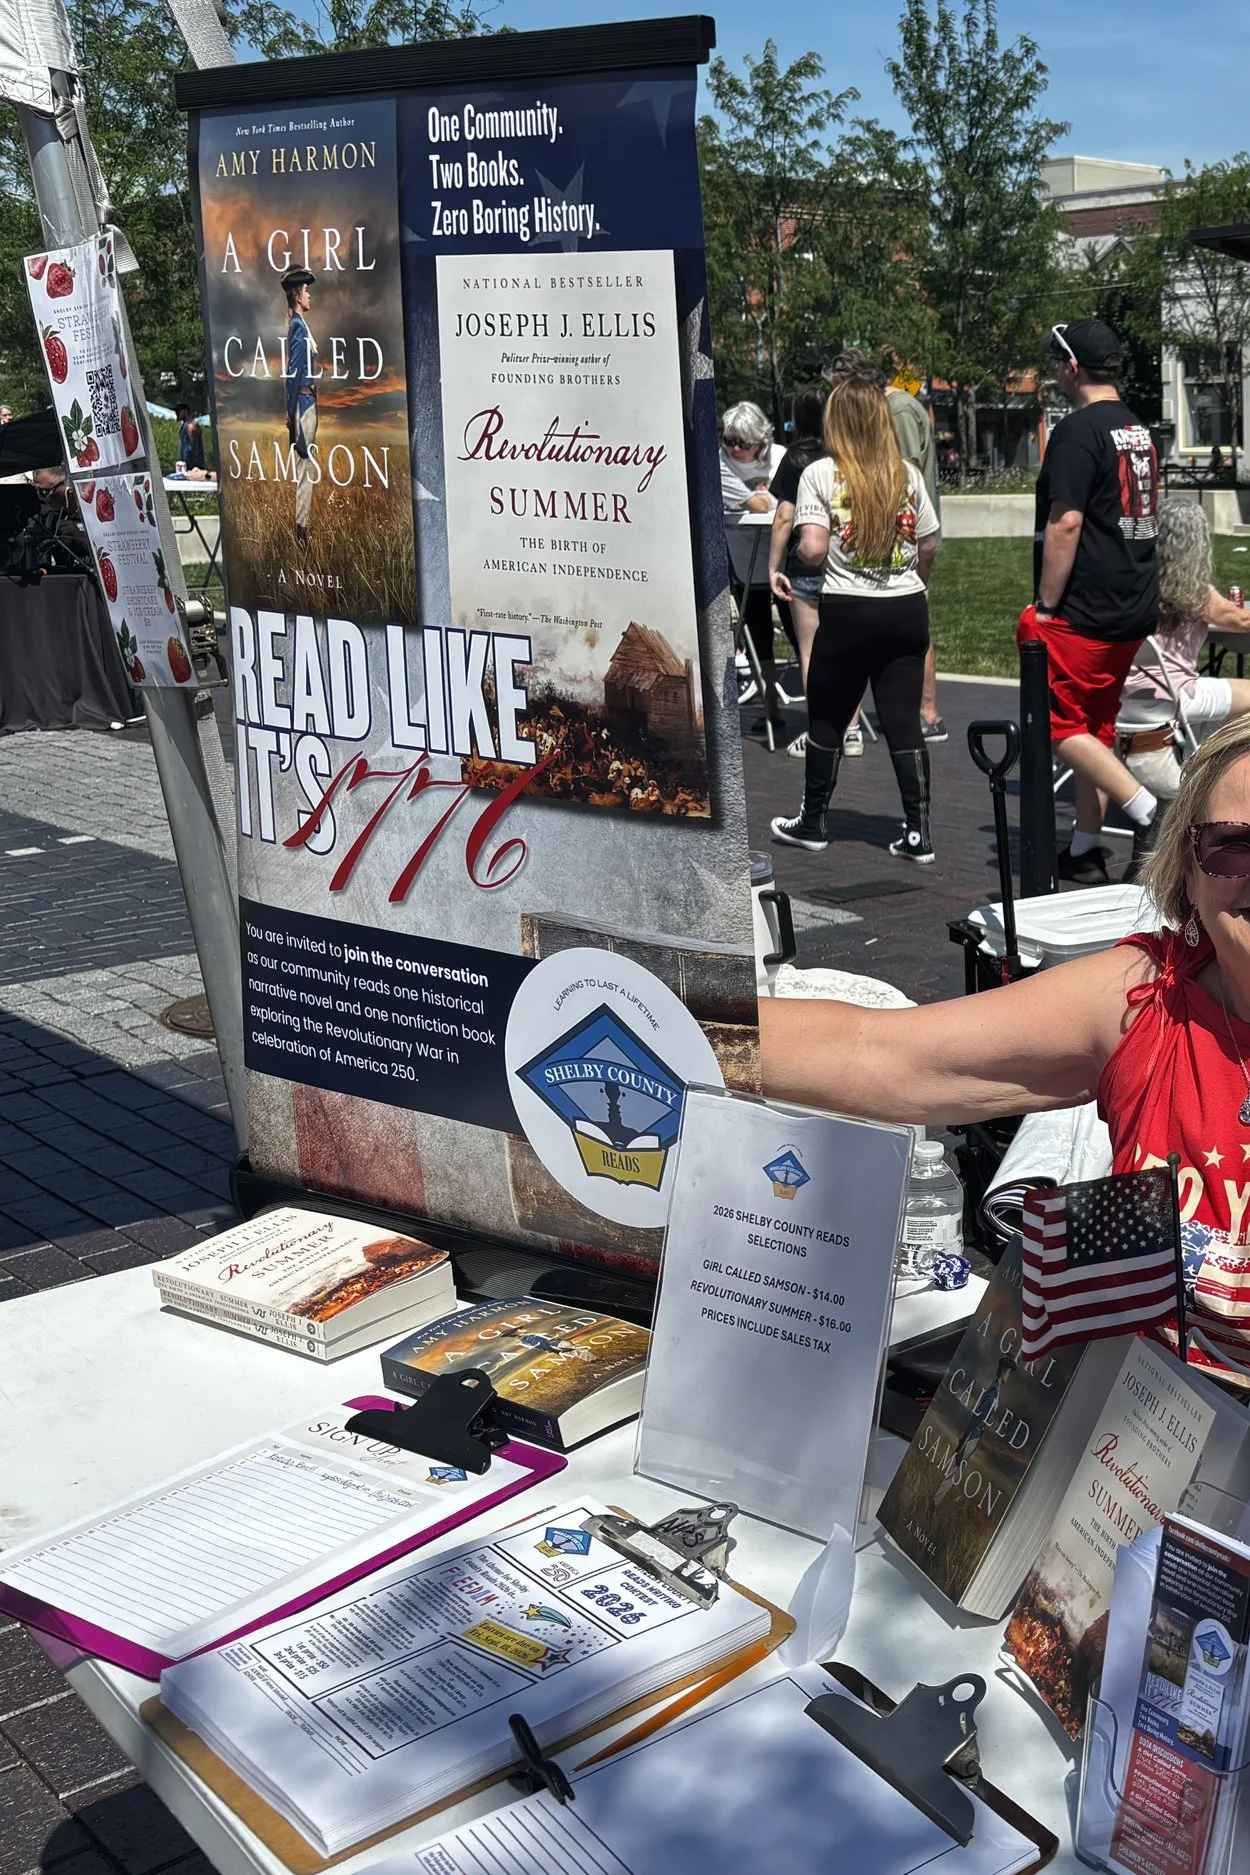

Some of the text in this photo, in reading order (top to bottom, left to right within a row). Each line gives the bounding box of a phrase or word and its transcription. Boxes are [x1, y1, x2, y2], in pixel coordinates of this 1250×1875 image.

[235, 117, 356, 137] New York Times Bestselling Author
[427, 99, 564, 145] One Community.
[216, 141, 376, 177] AMY HARMON
[429, 149, 525, 190] Two Books.
[431, 196, 601, 242] Zero Boring History.
[221, 226, 377, 273] A GIRL
[462, 275, 644, 290] NATIONAL BESTSELLER
[455, 312, 657, 338] JOSEPH J. ELLIS
[224, 336, 383, 380] CALLED
[491, 373, 621, 386] FOUNDING BROTHERS
[501, 352, 612, 368] Pulitzer Prize-winning author of
[229, 439, 390, 489] SAMSON
[456, 404, 668, 493] Revolutionary
[489, 485, 632, 524] SUMMER
[519, 536, 607, 554] THE BIRTH OF
[278, 568, 343, 589] A NOVEL
[483, 558, 649, 583] AMERICAN INDEPENDENCE
[553, 615, 589, 629] Washington
[589, 619, 603, 629] Post
[230, 606, 537, 765] READ LIKE
[236, 723, 562, 903] IT'S 1776
[245, 921, 489, 988] You are invited to join the conversation
[247, 951, 485, 1015] as our community reads one historical
[248, 975, 496, 1046] narrative novel and one nonfiction book
[553, 978, 660, 1032] LEARNING TO LAST A LIFETIME
[250, 1003, 460, 1065] exploring the Revolutionary War in
[251, 1029, 420, 1082] celebration of America 250.
[544, 1063, 678, 1106] SHELBY COUNTY
[601, 1149, 641, 1174] READS
[181, 1240, 240, 1272] JOSEPH
[253, 1213, 298, 1236] ELLIS
[713, 1204, 850, 1248] 2026 SHELBY COUNTY READS
[747, 1233, 807, 1258] SELECTIONS
[217, 1221, 334, 1285] Revolutionary
[251, 1235, 335, 1279] SUMMER
[156, 1274, 215, 1299] REVOLUTIONARY
[220, 1294, 249, 1309] SUMMER
[702, 1259, 724, 1274] GIRL
[725, 1265, 762, 1284] CALLED
[762, 1275, 807, 1296] SAMSON
[812, 1288, 845, 1306] $14.00
[269, 1309, 296, 1323] JOSEPH
[275, 1318, 297, 1331] ELLIS
[412, 1300, 532, 1354] AMY HARMON
[690, 1280, 769, 1310] REVOLUTIONARY
[768, 1301, 812, 1323] SUMMER
[818, 1315, 852, 1333] $16.00
[976, 1311, 993, 1338] A
[444, 1308, 561, 1364] A GIRL
[476, 1316, 598, 1376] CALLED
[701, 1306, 832, 1354] PRICES INCLUDE SALES TAX
[509, 1328, 638, 1390] SAMSON
[603, 1353, 642, 1371] NOVEL
[949, 1367, 1031, 1451] CALLED
[1121, 1371, 1199, 1454] JOSEPH J. ELLIS
[308, 1421, 401, 1456] SIGN UP
[918, 1424, 1002, 1518] SAMSON
[913, 1526, 937, 1557] NOVEL
[1070, 1517, 1096, 1548] AMERICAN
[1090, 1517, 1117, 1550] THE BIRTH
[558, 1560, 581, 1576] AMERICA
[621, 1569, 650, 1590] READS
[648, 1586, 682, 1610] WRITING
[580, 1584, 648, 1625] 2026
[619, 1581, 659, 1607] CONTEST
